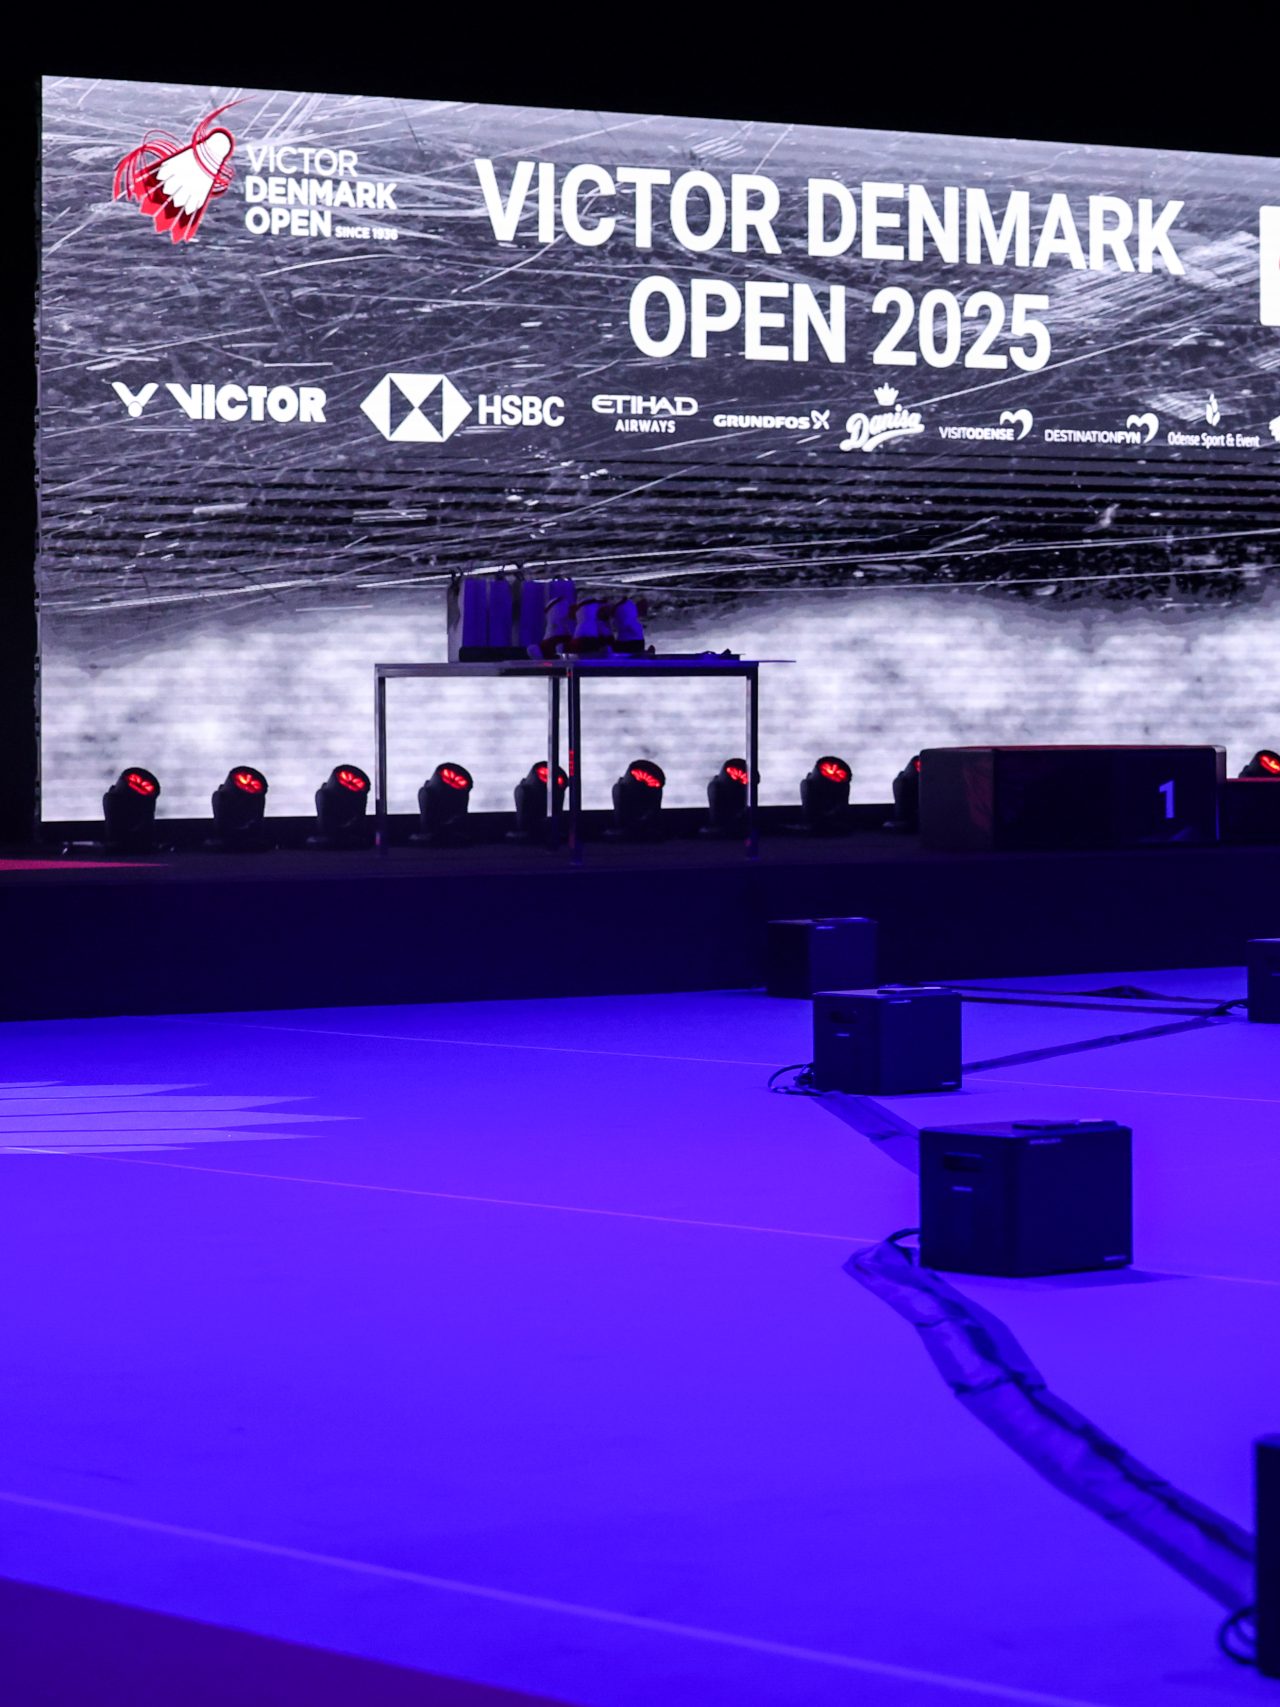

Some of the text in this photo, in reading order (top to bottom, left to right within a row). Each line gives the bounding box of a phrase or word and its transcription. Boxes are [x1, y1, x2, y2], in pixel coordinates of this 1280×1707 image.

[245, 145, 359, 177] VICTOR
[244, 177, 398, 209] DENMARK
[245, 207, 332, 238] OPEN
[335, 226, 371, 239] SINCE
[474, 159, 1186, 275] VICTOR DENMARK
[628, 276, 1051, 371] OPEN 2025
[165, 383, 327, 423] VICTOR
[478, 394, 565, 428] HSBC
[591, 394, 698, 416] ETIHAD
[615, 419, 676, 434] AIRWAYS
[713, 414, 810, 430] GRUNDFOS
[839, 404, 925, 452] Danisa
[1044, 429, 1141, 444] DESTINATIONFYN
[1167, 432, 1260, 450] Odense Sport & Event
[1158, 780, 1176, 819] 1
